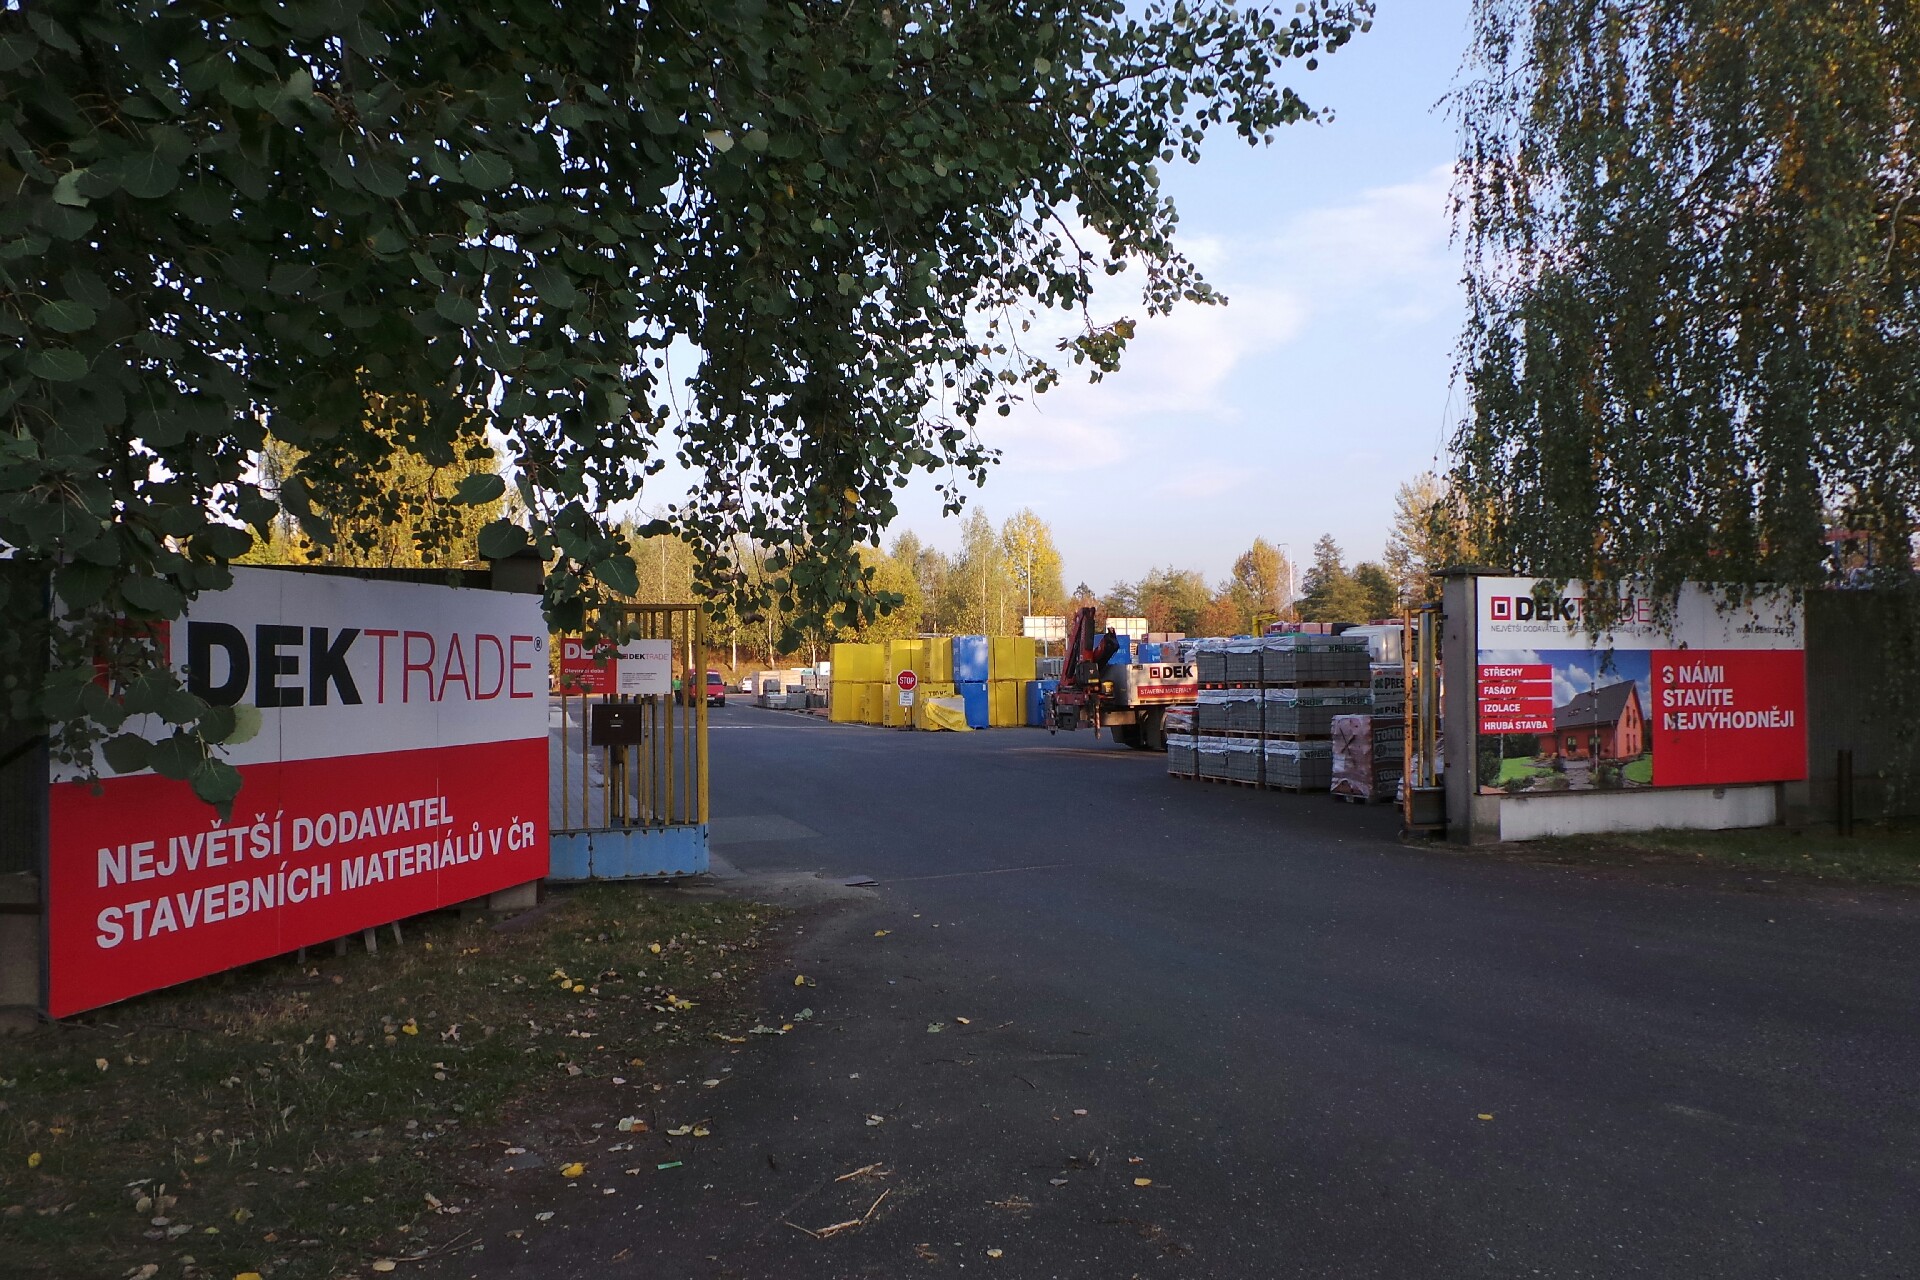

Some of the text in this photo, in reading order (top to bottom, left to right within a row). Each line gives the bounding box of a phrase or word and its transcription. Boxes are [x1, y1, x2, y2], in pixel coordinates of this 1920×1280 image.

[1163, 665, 1193, 678] DEK
[1484, 666, 1523, 677] STŘECHY
[1662, 660, 1724, 684] S NÁMI
[900, 676, 915, 685] STOP
[1484, 684, 1517, 695] FASÁDY
[1663, 684, 1734, 707] STAVÍTE
[1484, 703, 1521, 713] IZOLACE
[1484, 719, 1548, 730] HRUBÁ STAVBA
[1664, 705, 1795, 731] NEJVÝHODNĚJI
[97, 796, 453, 889] NEJVĚTŠÍ DODAVATEL
[96, 816, 535, 949] STAVEBNÍCH MATERIÁLŮ V ČR
